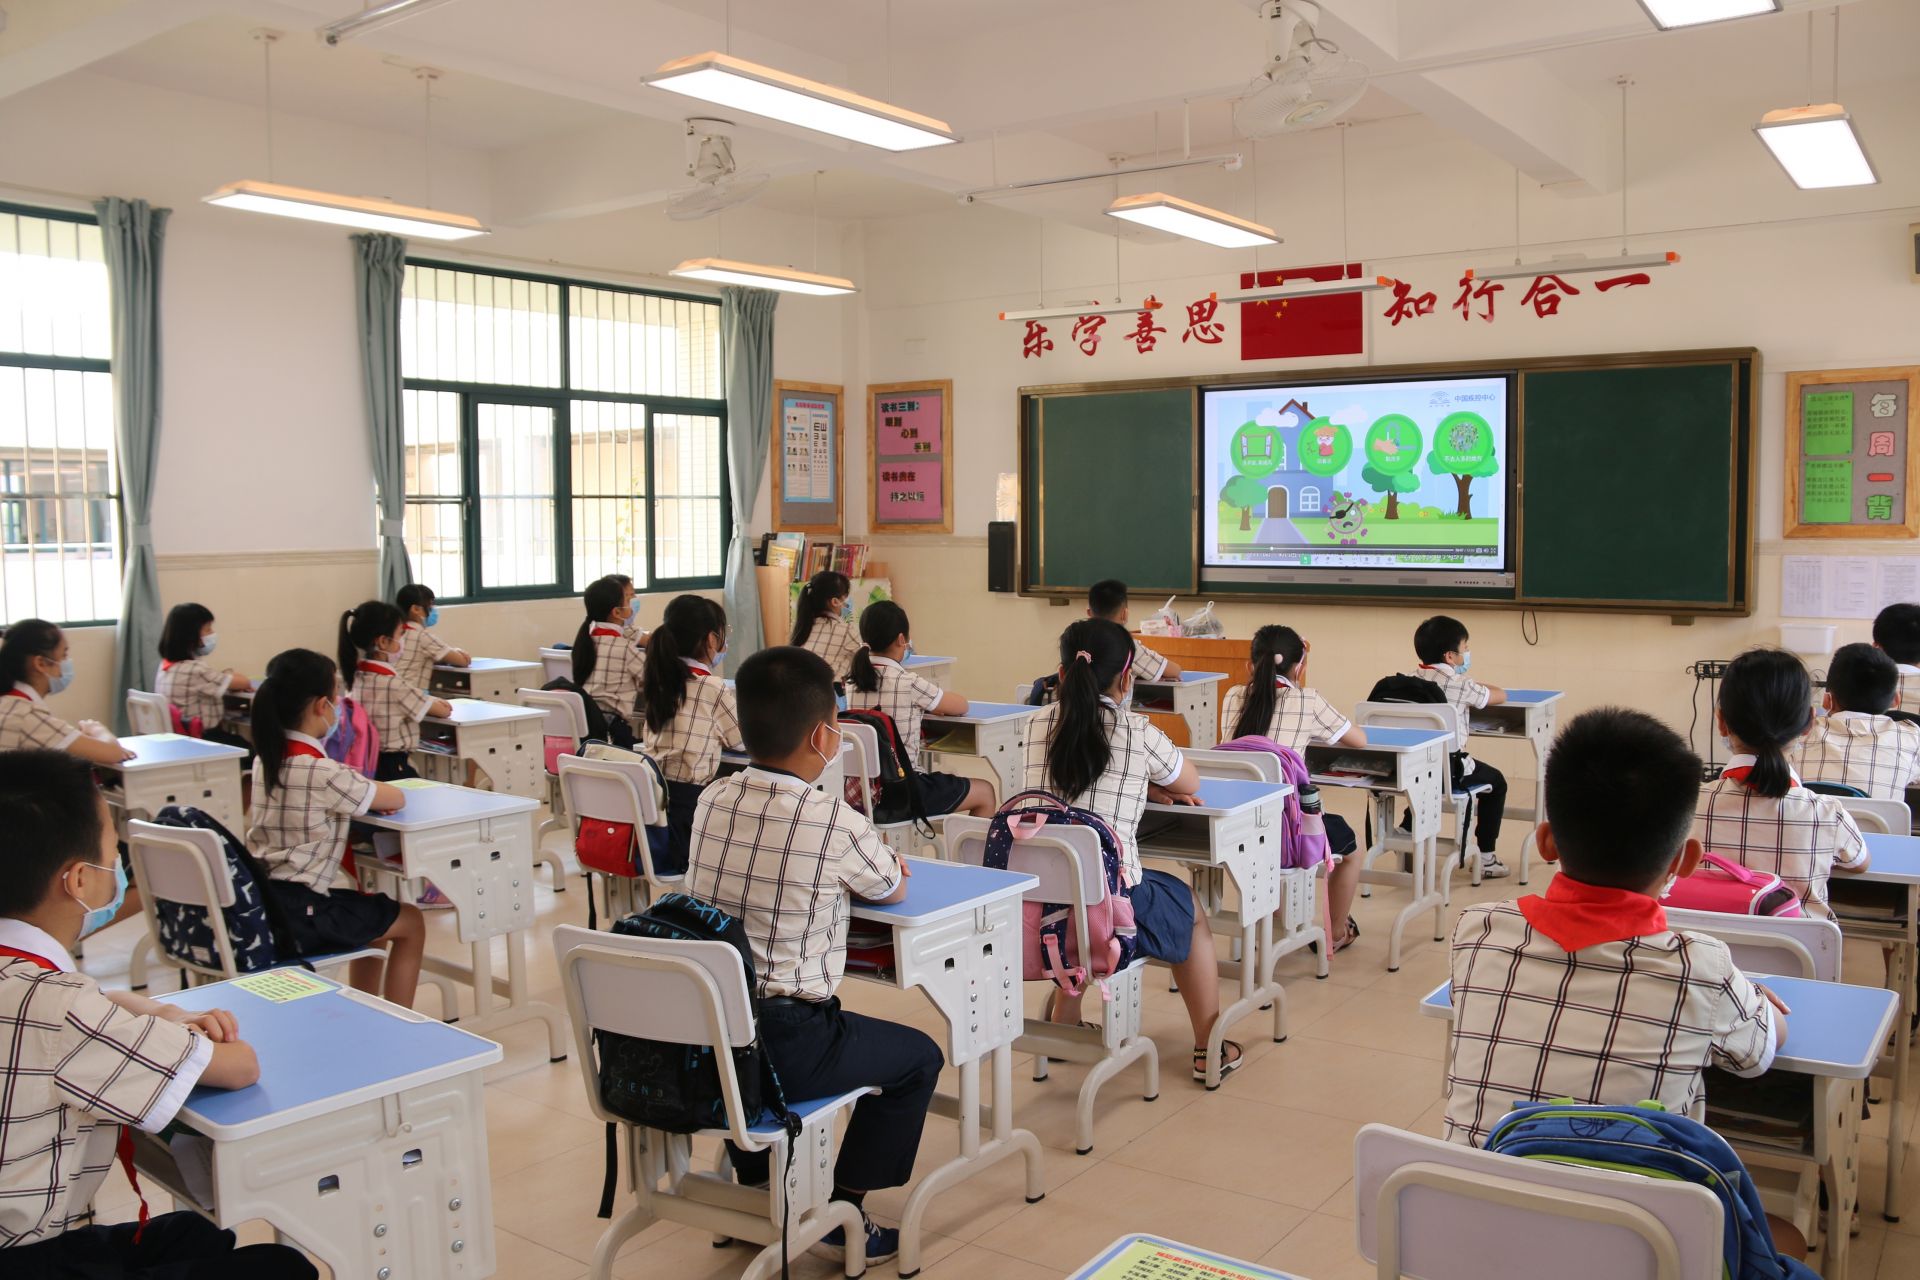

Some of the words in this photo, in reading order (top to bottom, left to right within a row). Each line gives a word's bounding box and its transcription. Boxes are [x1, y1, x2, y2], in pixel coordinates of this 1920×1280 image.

[1384, 272, 1651, 326] 知行合一
[1023, 295, 1225, 359] 乐学善思
[901, 428, 918, 439] 心到
[890, 491, 925, 502] 持之以恒
